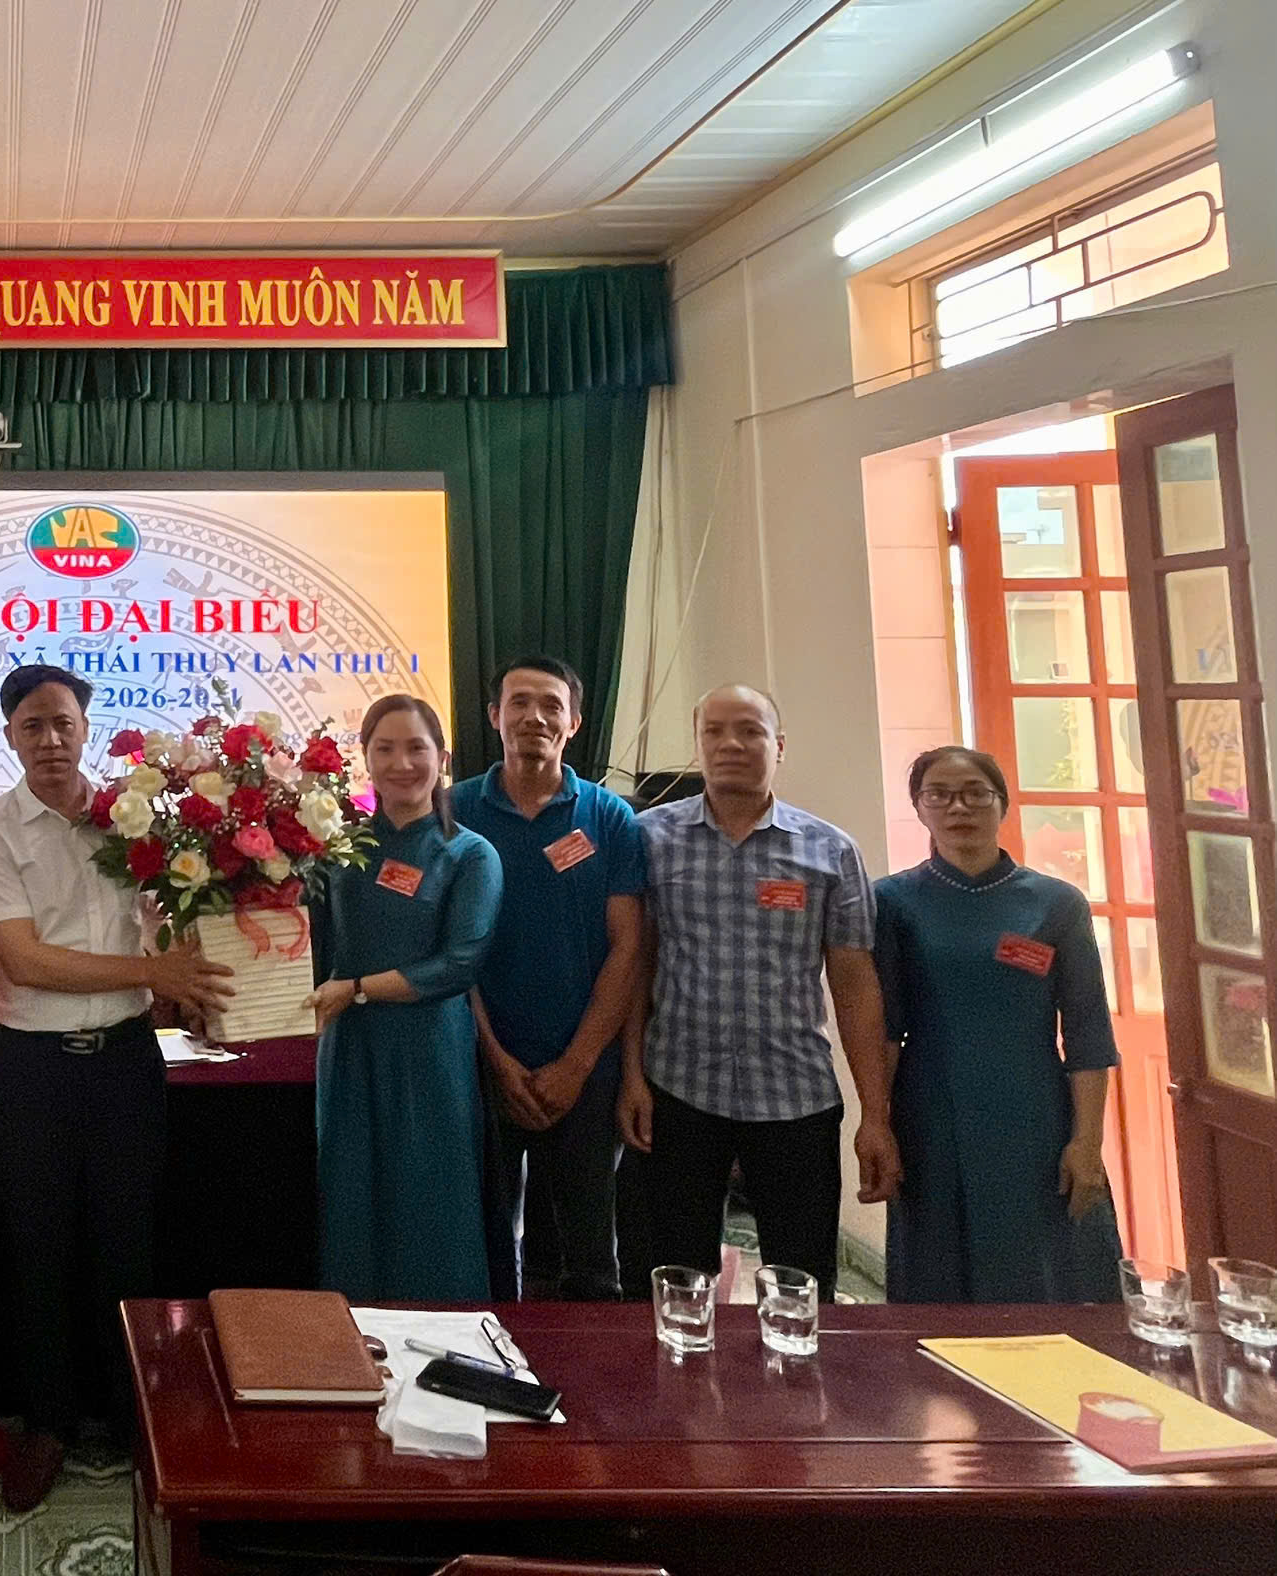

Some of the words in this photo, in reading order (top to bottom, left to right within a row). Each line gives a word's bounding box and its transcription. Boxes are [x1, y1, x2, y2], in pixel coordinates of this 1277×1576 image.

[122, 280, 227, 326] VINH
[238, 266, 360, 326] MUÔN
[372, 269, 465, 325] NĂM
[53, 554, 112, 568] VINA
[77, 599, 173, 643] ĐẠI
[61, 645, 141, 672] THÁI
[151, 652, 241, 678] THỤY
